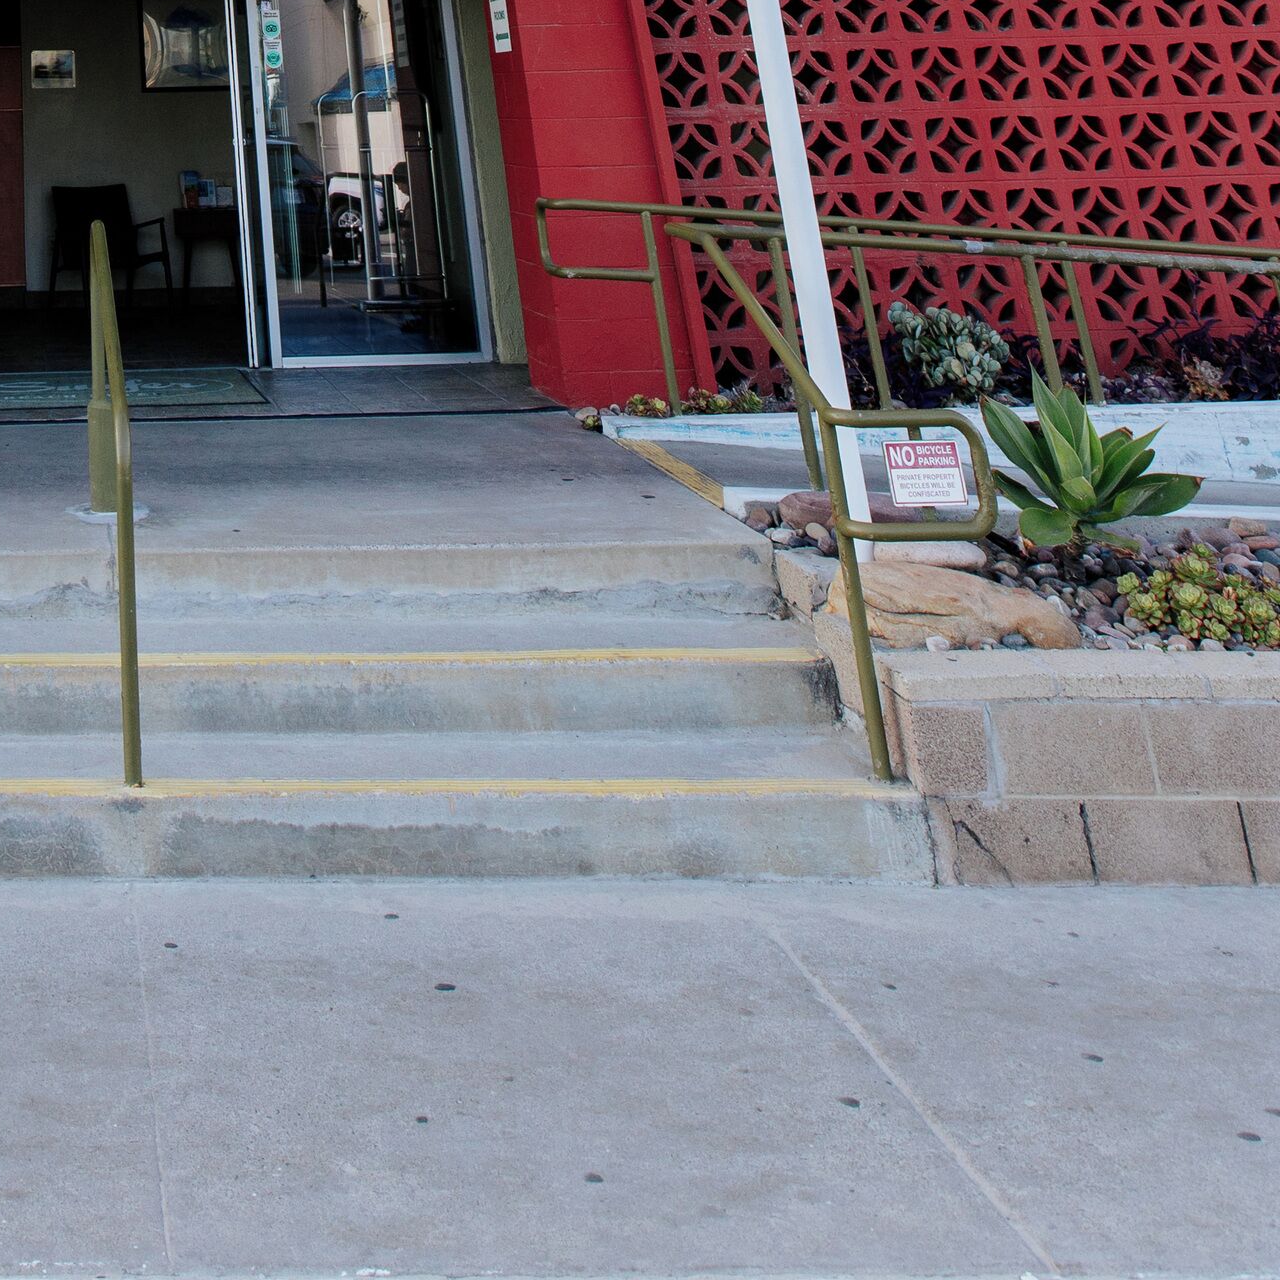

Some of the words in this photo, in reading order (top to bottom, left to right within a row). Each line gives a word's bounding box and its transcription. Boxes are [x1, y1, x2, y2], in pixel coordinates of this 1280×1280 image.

[494, 10, 506, 20] ROOMS
[916, 445, 952, 454] BICYCLE
[889, 446, 915, 466] NO
[918, 456, 956, 465] PARKING
